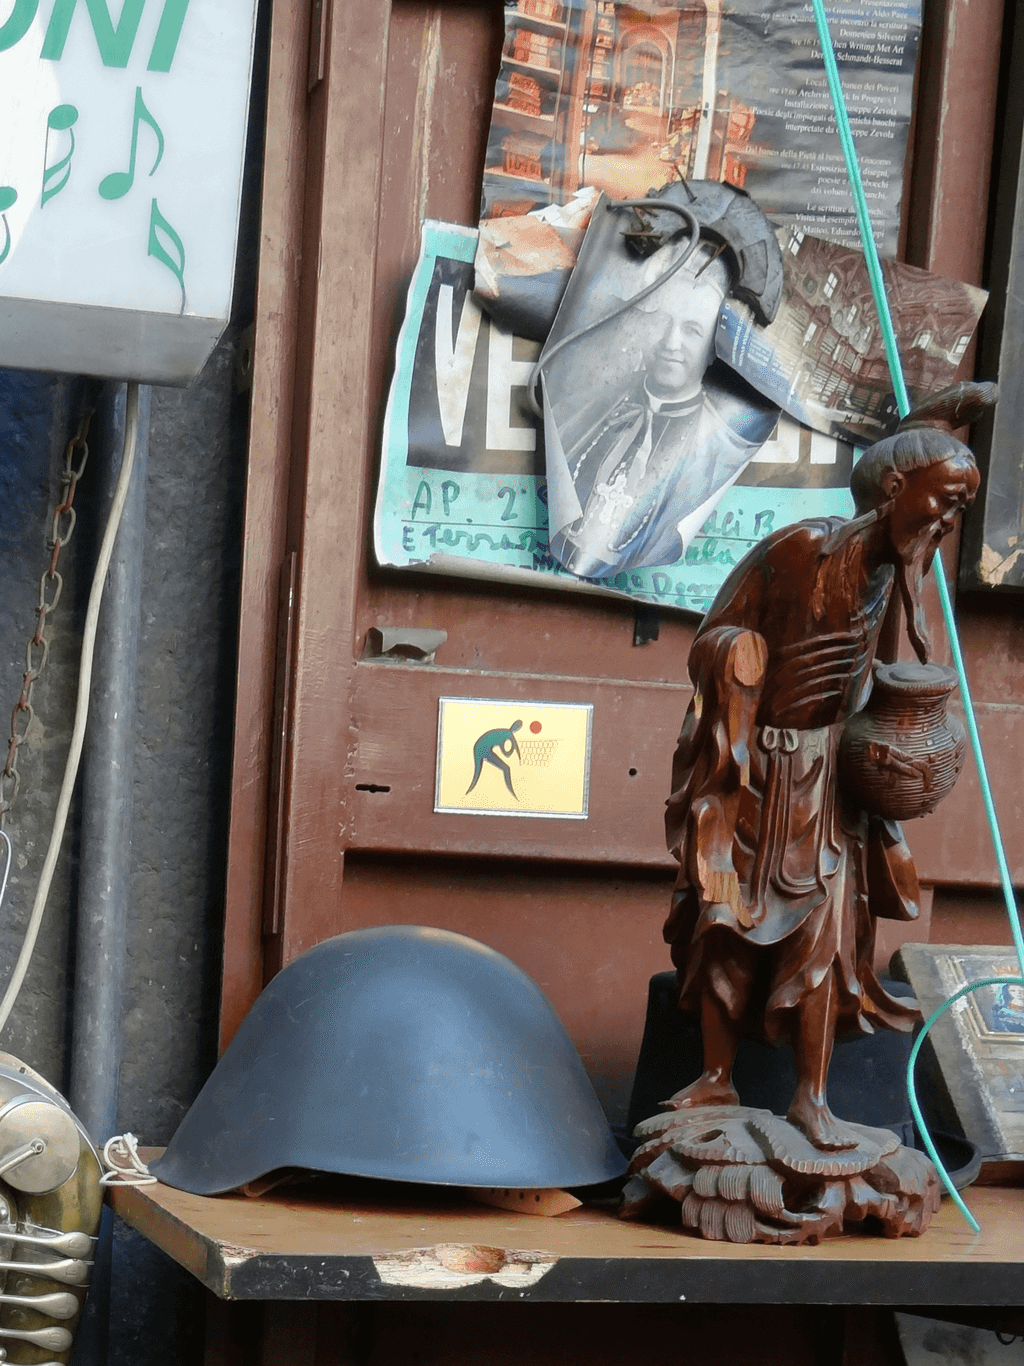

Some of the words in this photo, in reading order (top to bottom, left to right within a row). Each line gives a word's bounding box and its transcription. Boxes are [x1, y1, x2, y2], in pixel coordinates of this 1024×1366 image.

[840, 28, 875, 40] Domenico
[876, 32, 906, 42] Silvestri
[848, 42, 875, 53] Writing
[876, 44, 892, 52] Met
[893, 46, 904, 54] Art
[837, 52, 903, 66] Schmandt-Besserat
[876, 84, 900, 94] Poveri
[784, 100, 827, 110] Installazione
[872, 106, 897, 116] Zevola
[785, 122, 824, 134] interpretate
[826, 125, 834, 134] da
[870, 128, 894, 139] Zevola
[780, 150, 798, 158] della
